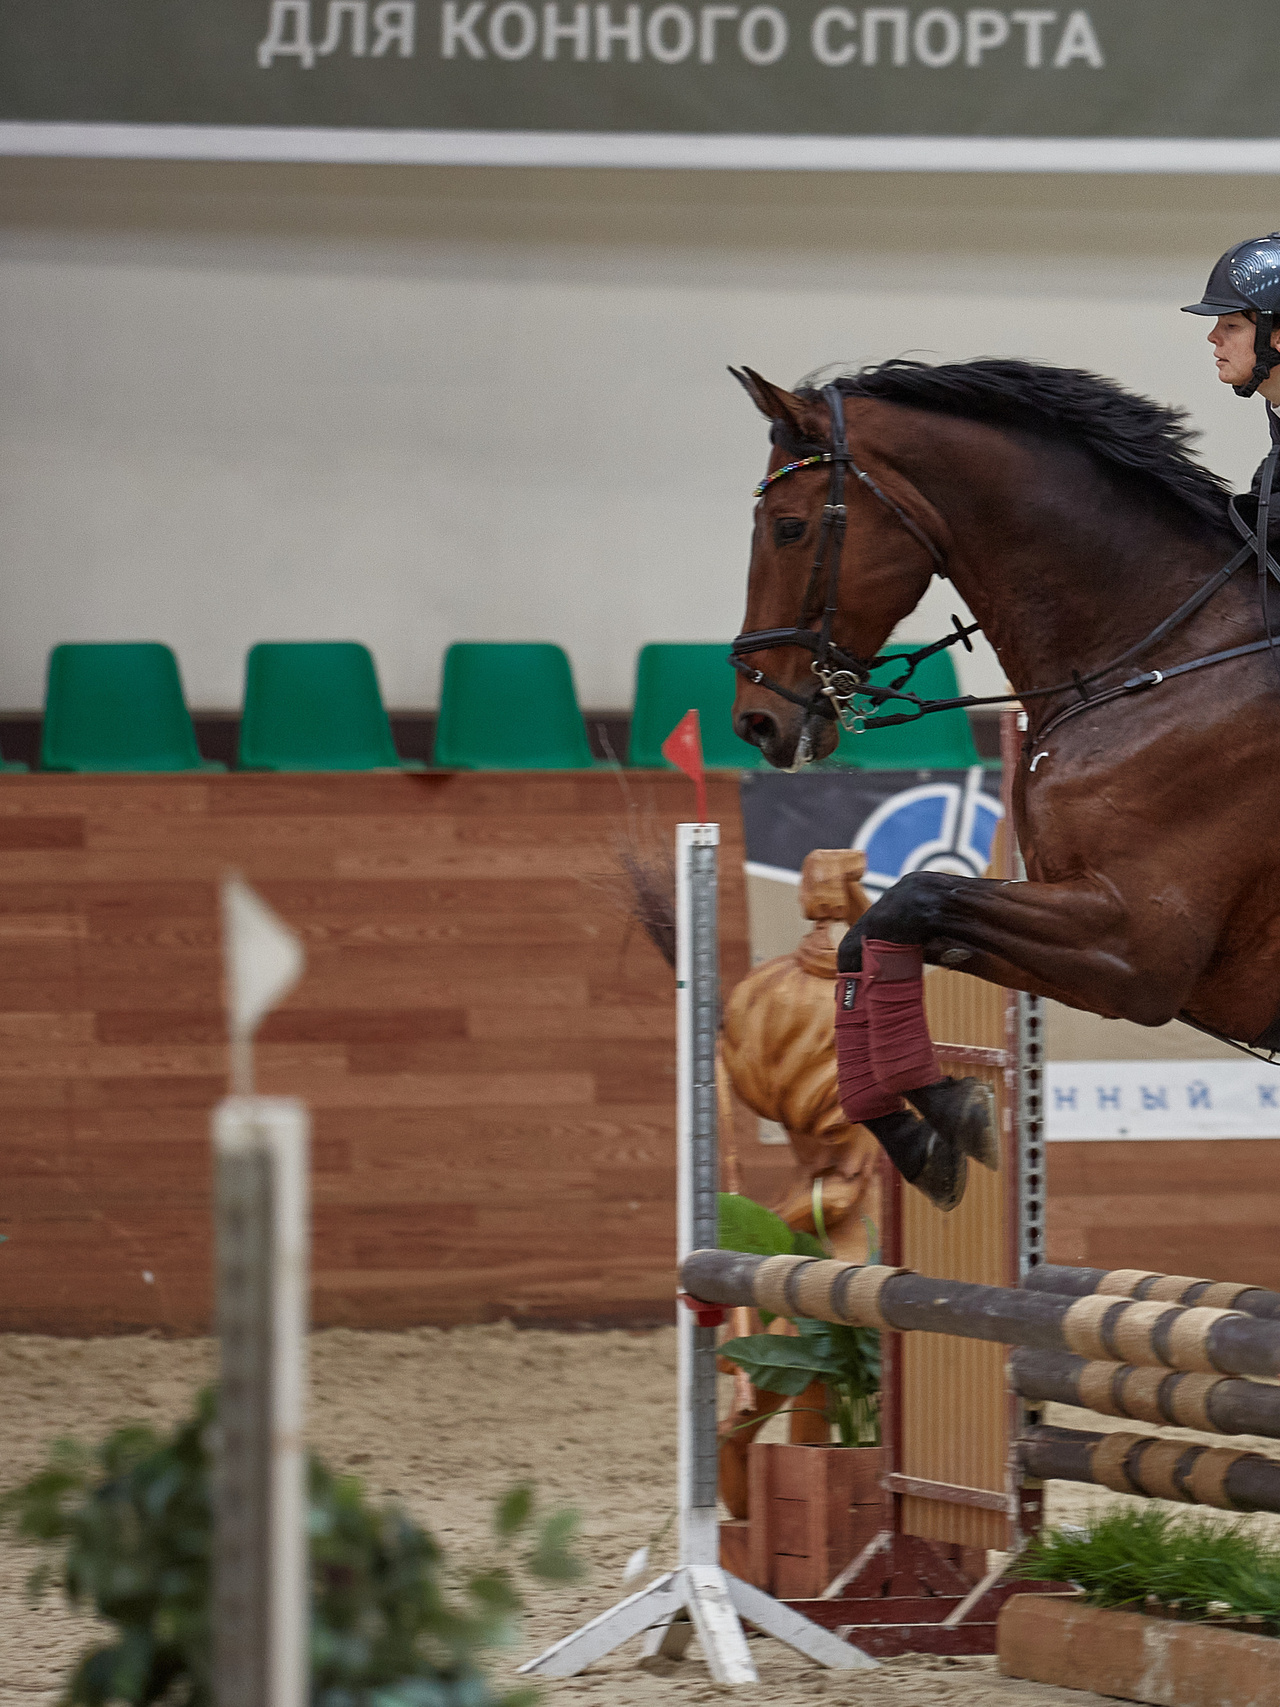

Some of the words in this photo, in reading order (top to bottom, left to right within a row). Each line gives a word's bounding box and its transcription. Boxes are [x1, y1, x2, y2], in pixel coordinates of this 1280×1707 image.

[257, 0, 415, 69] ДЛЯ
[440, 1, 789, 65] КОННОГО
[810, 8, 1105, 69] СПОРТА
